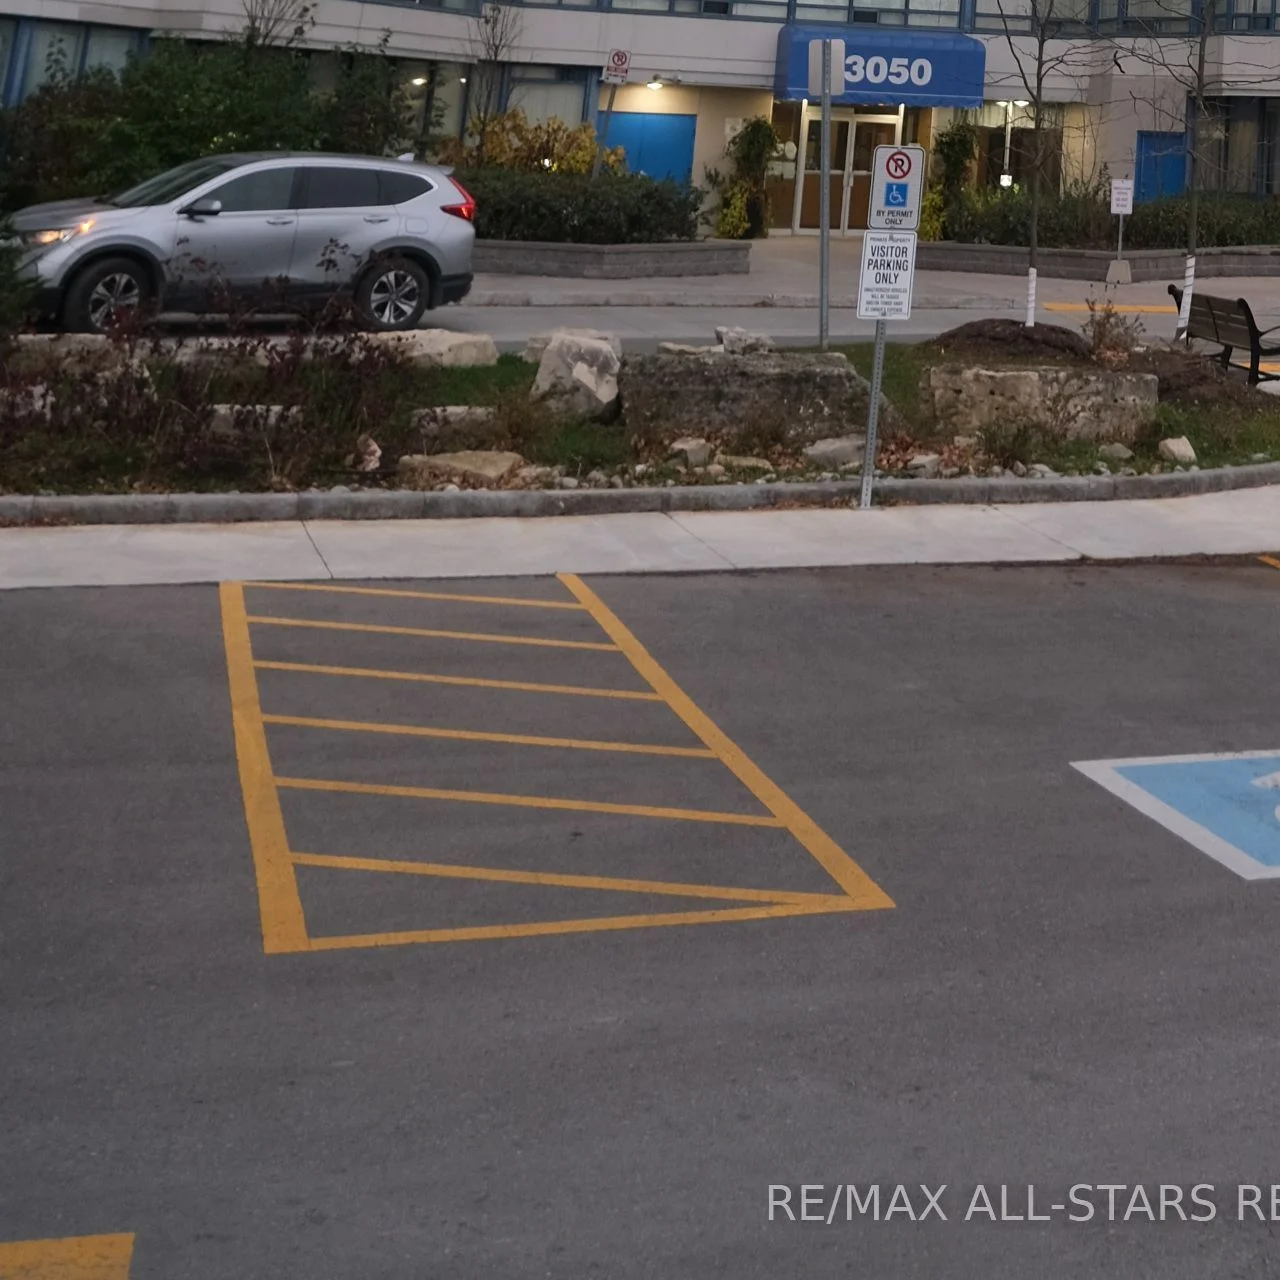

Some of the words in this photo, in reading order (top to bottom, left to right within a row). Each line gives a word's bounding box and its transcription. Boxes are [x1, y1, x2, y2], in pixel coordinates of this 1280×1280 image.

[844, 54, 932, 86] 3050
[876, 209, 885, 217] BY
[887, 209, 913, 218] PERMIT
[871, 245, 908, 258] VISITOR
[867, 258, 909, 271] PARKING
[874, 272, 899, 284] ONLY
